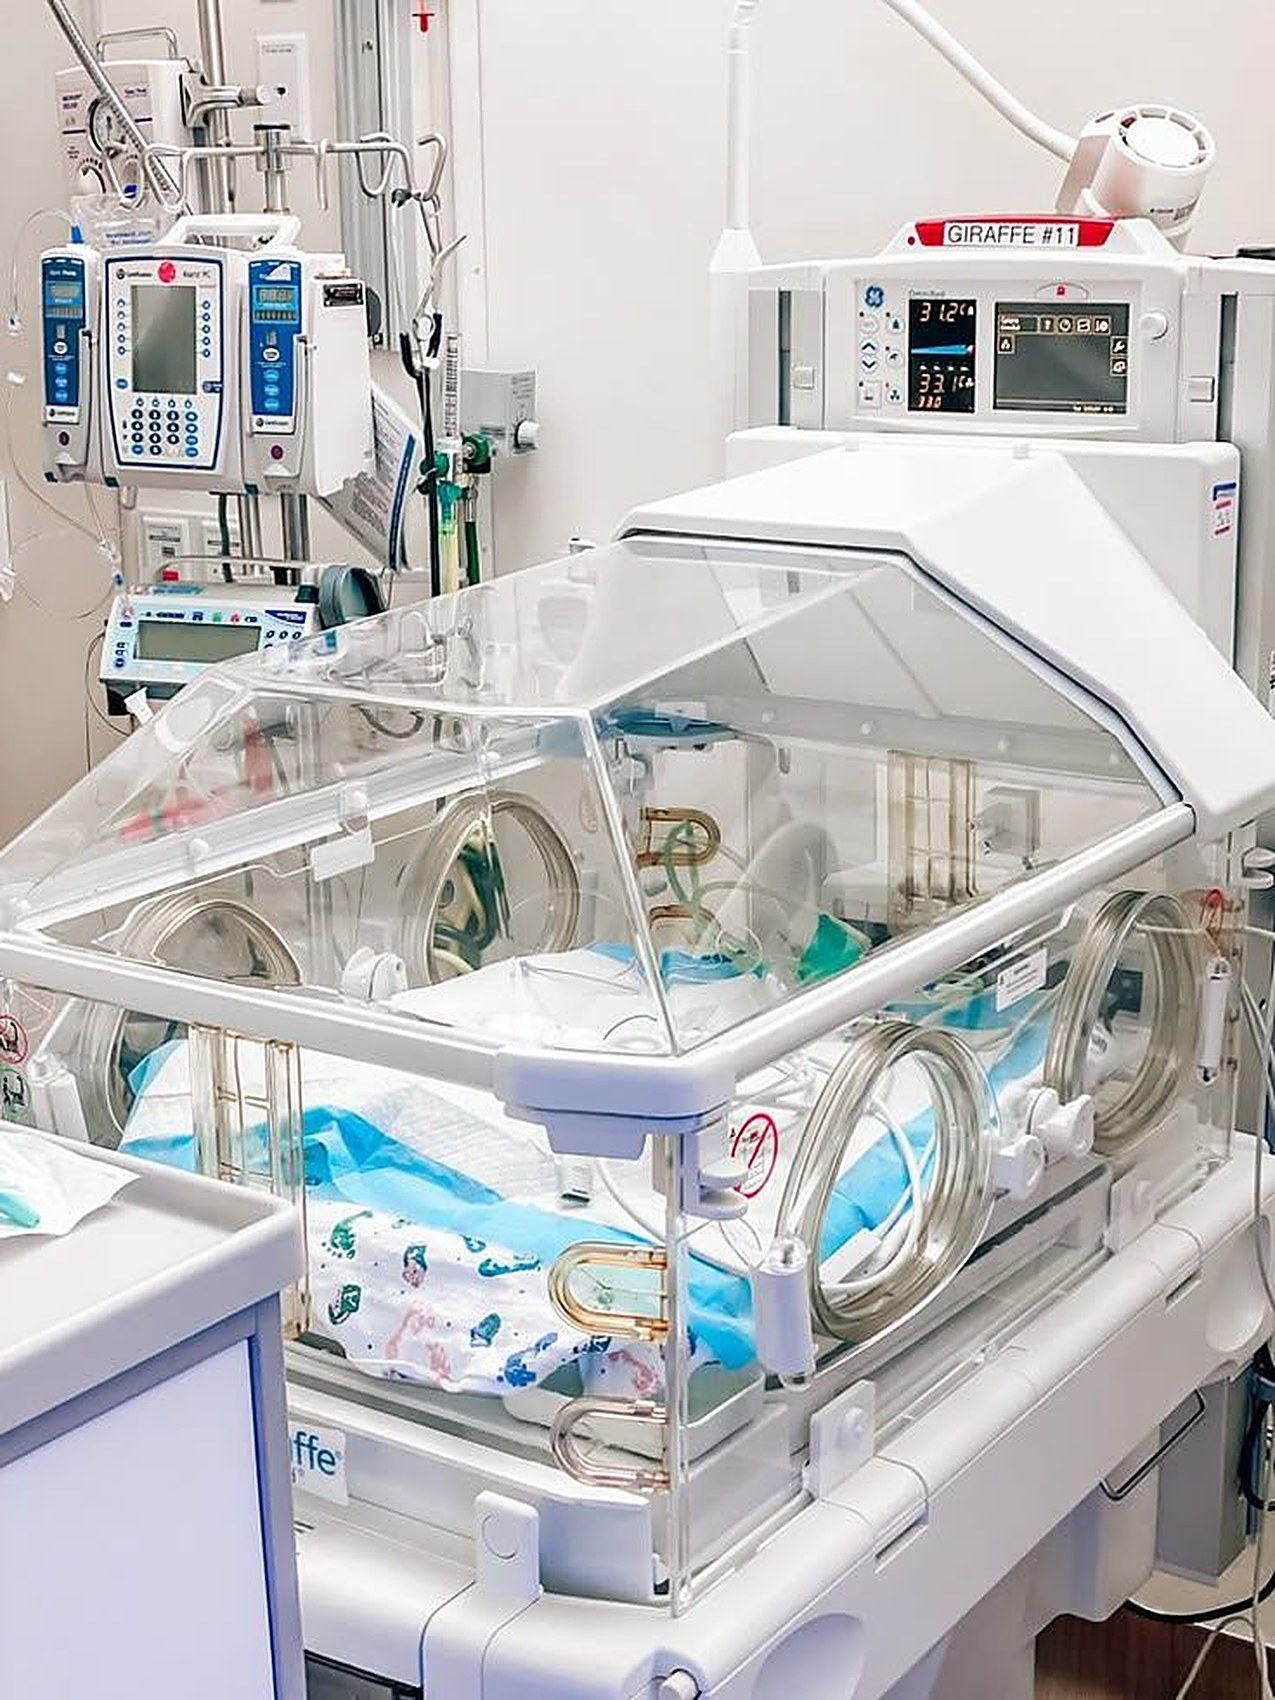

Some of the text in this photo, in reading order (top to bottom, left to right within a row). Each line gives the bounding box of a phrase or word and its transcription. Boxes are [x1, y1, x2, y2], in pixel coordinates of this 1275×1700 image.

[947, 225, 1075, 245] GIRAFFE #11
[290, 1431, 336, 1476] ffe
